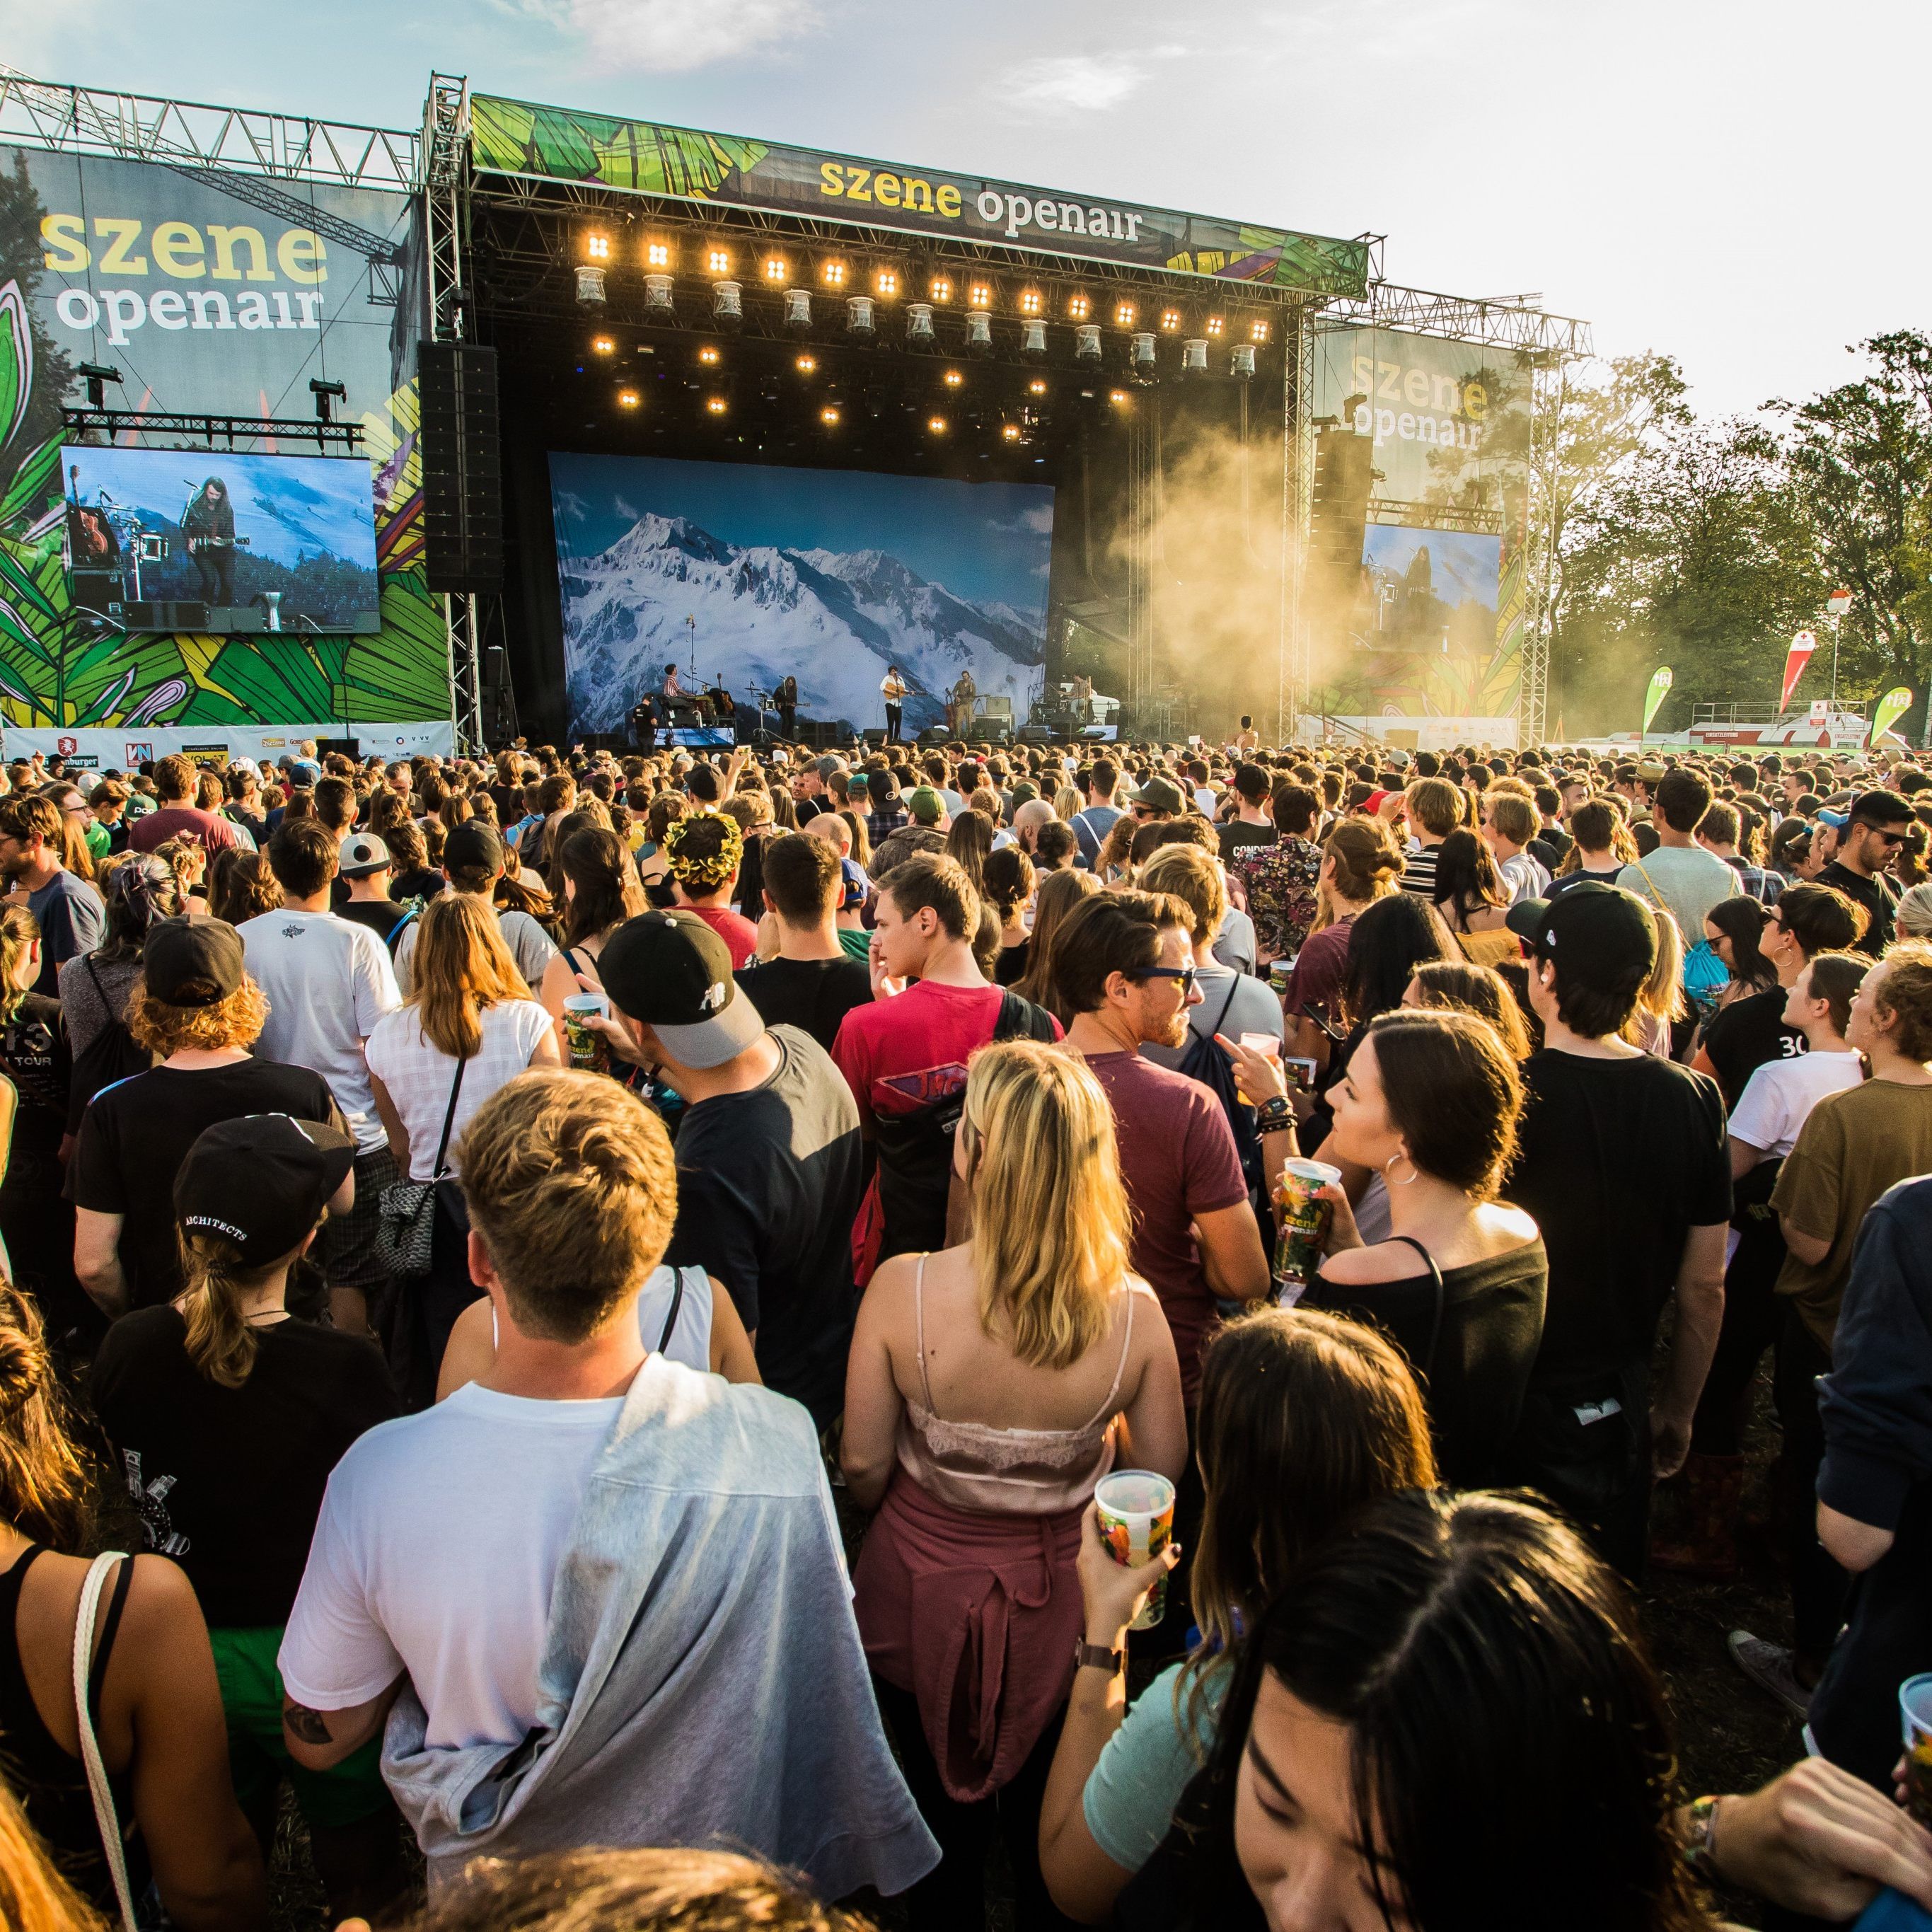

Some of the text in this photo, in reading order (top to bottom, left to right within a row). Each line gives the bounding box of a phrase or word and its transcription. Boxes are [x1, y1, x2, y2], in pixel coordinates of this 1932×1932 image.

[820, 162, 1143, 242] szene openair
[40, 214, 328, 284] szene
[56, 288, 325, 346] openair
[1350, 356, 1488, 421] szene
[1354, 405, 1482, 451] openair
[127, 745, 151, 760] VN
[14, 1057, 52, 1066] TOUR
[185, 1215, 248, 1241] ARCHITECTS
